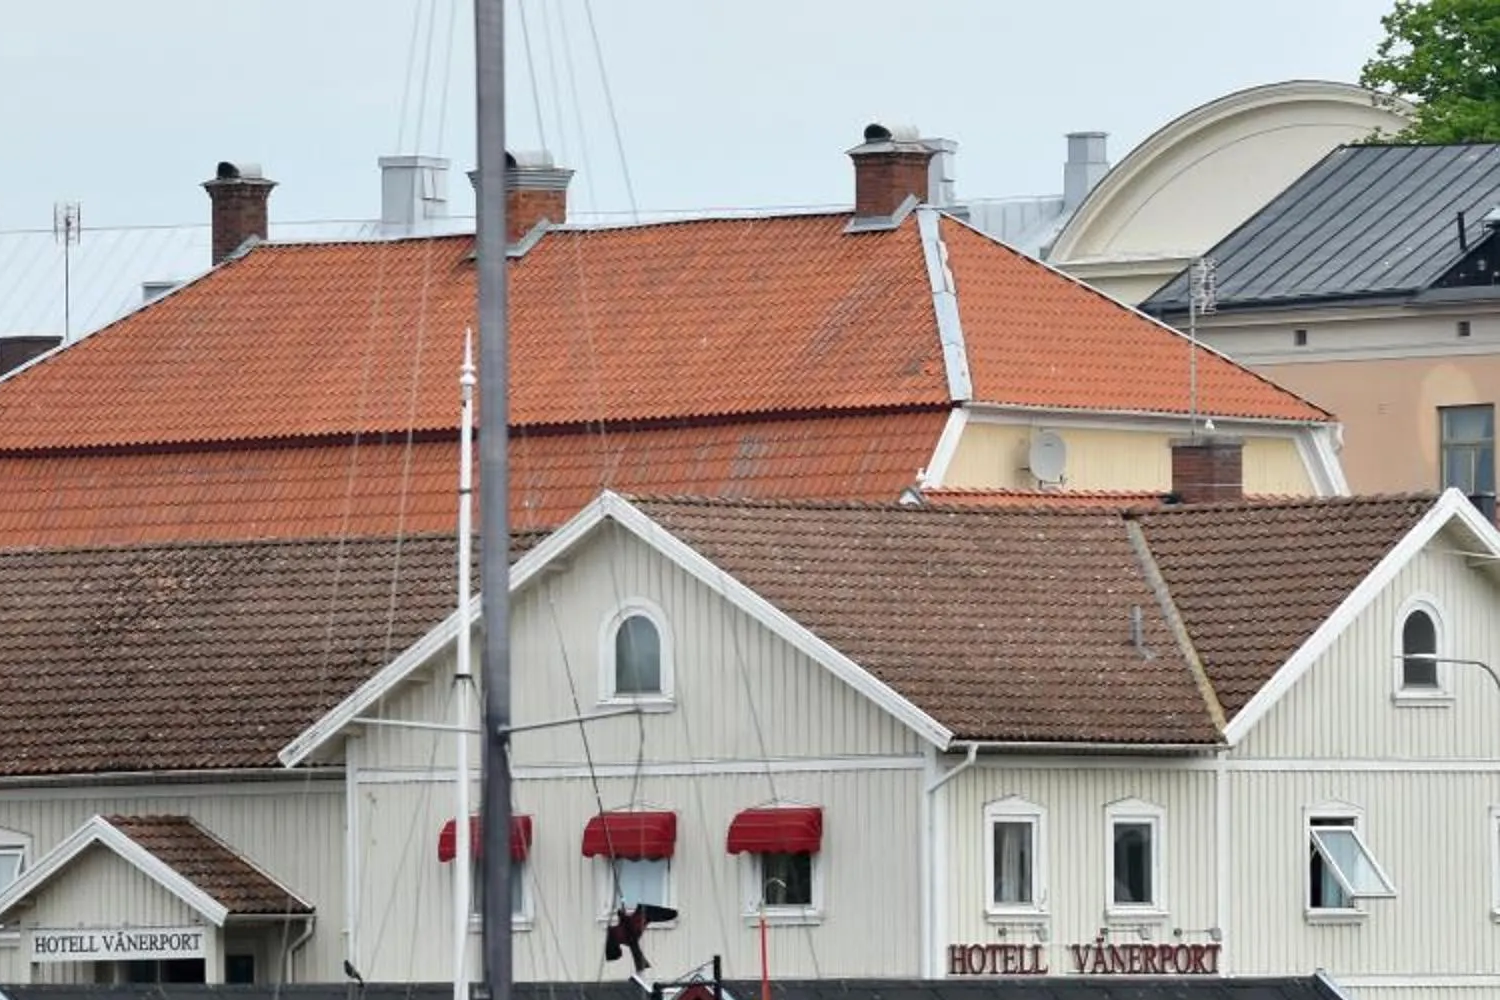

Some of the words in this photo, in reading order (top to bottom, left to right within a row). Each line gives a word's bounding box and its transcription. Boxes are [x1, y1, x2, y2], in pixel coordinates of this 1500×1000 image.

[35, 936, 99, 953] HOTELL
[102, 931, 202, 951] VÄNERPORT
[948, 944, 1048, 975] HOTELL
[1066, 937, 1222, 975] VÄNERPORT
